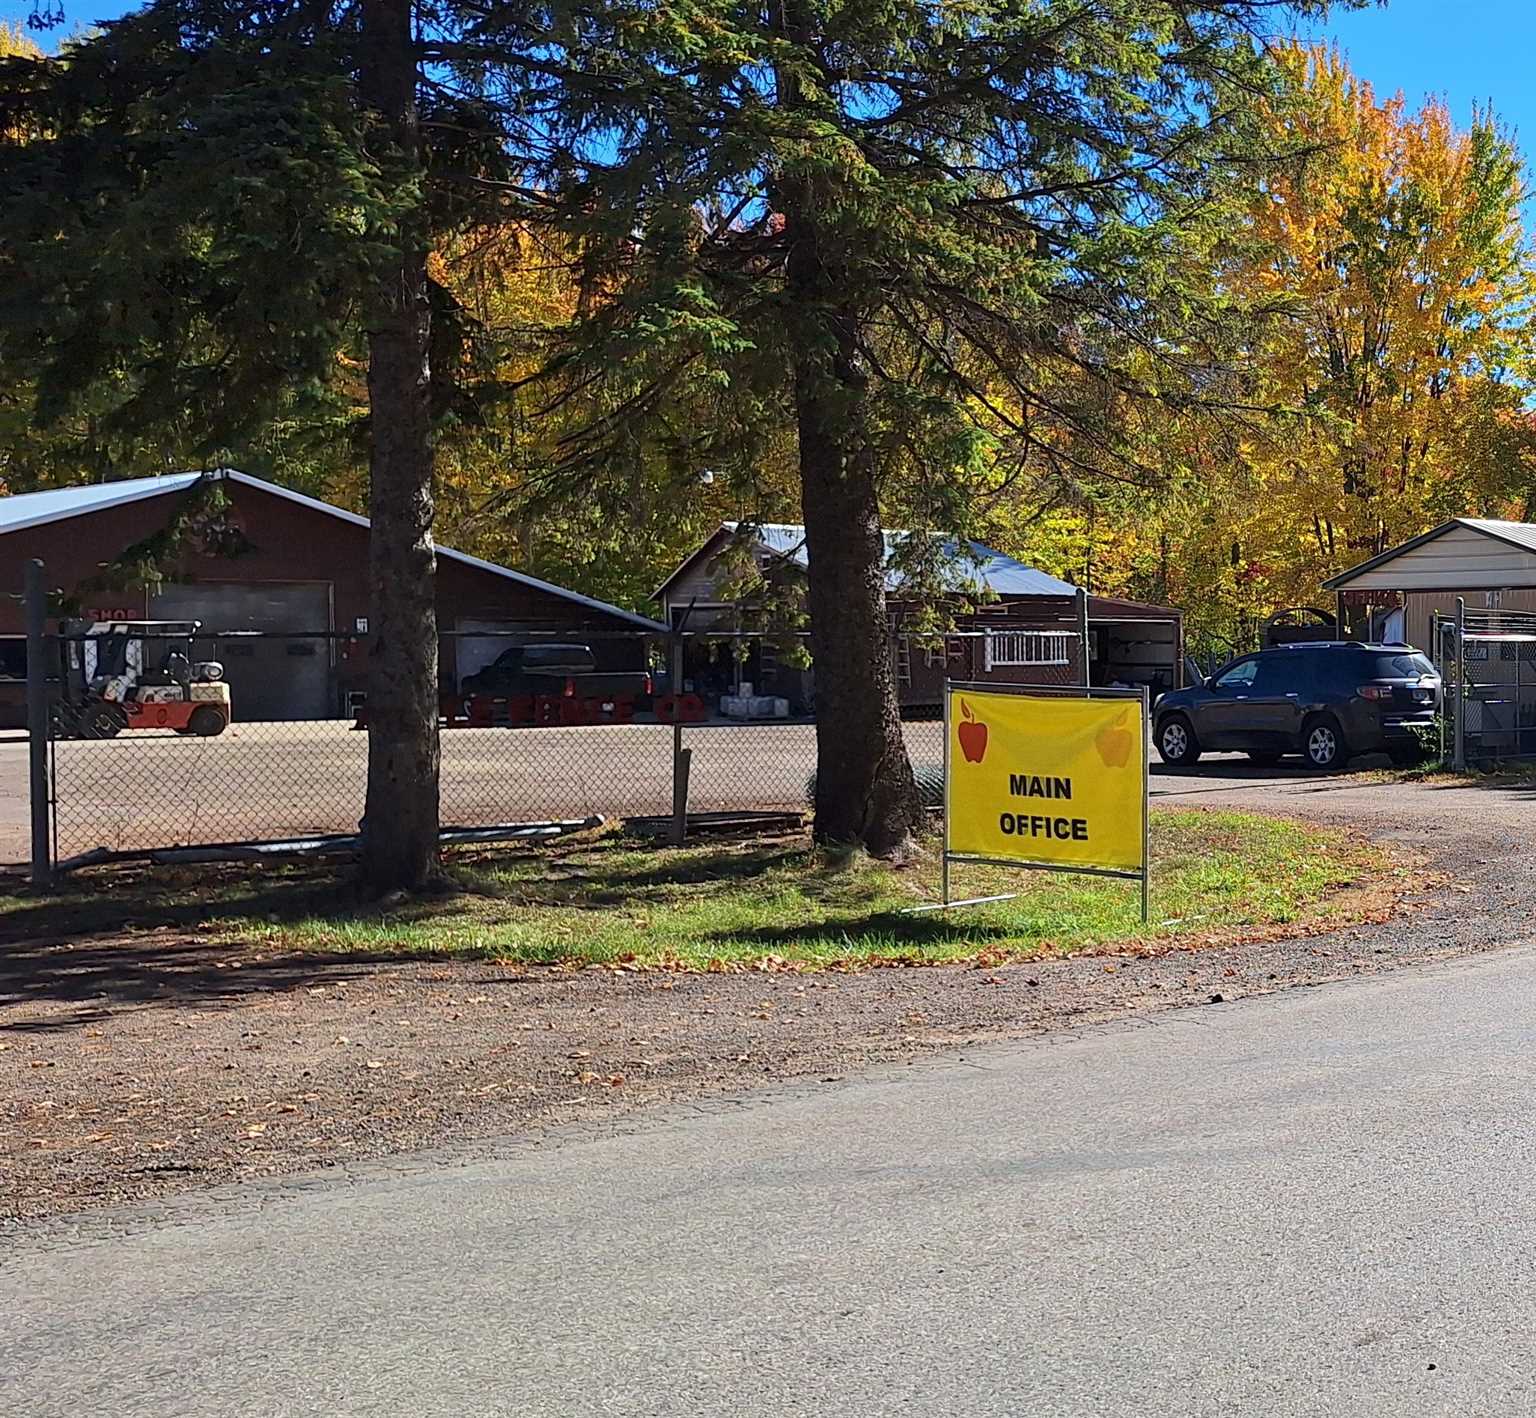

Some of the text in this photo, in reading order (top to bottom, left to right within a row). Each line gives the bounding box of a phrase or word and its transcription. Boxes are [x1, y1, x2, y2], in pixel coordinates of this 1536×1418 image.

[87, 608, 137, 620] SHOP
[1009, 774, 1072, 800] MAIN
[999, 813, 1089, 841] OFFICE
